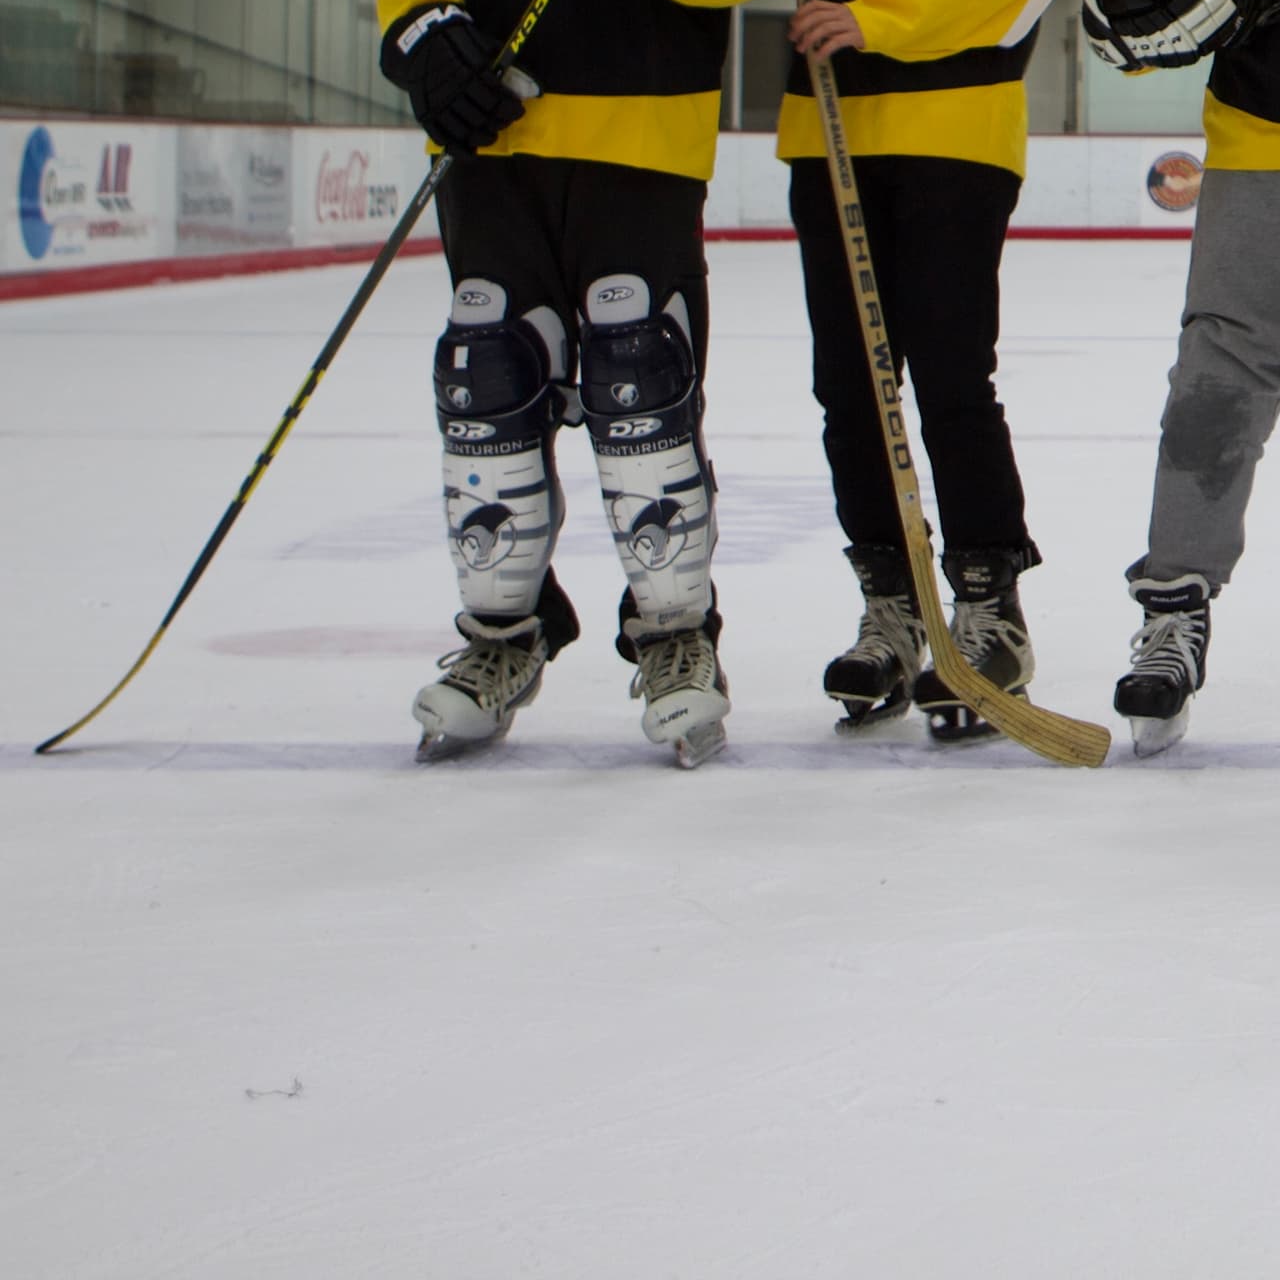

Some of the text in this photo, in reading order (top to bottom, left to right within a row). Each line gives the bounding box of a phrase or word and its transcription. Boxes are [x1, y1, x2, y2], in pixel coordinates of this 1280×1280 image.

[448, 421, 491, 440] DR
[609, 418, 658, 438] DR
[598, 435, 679, 455] CENTURION
